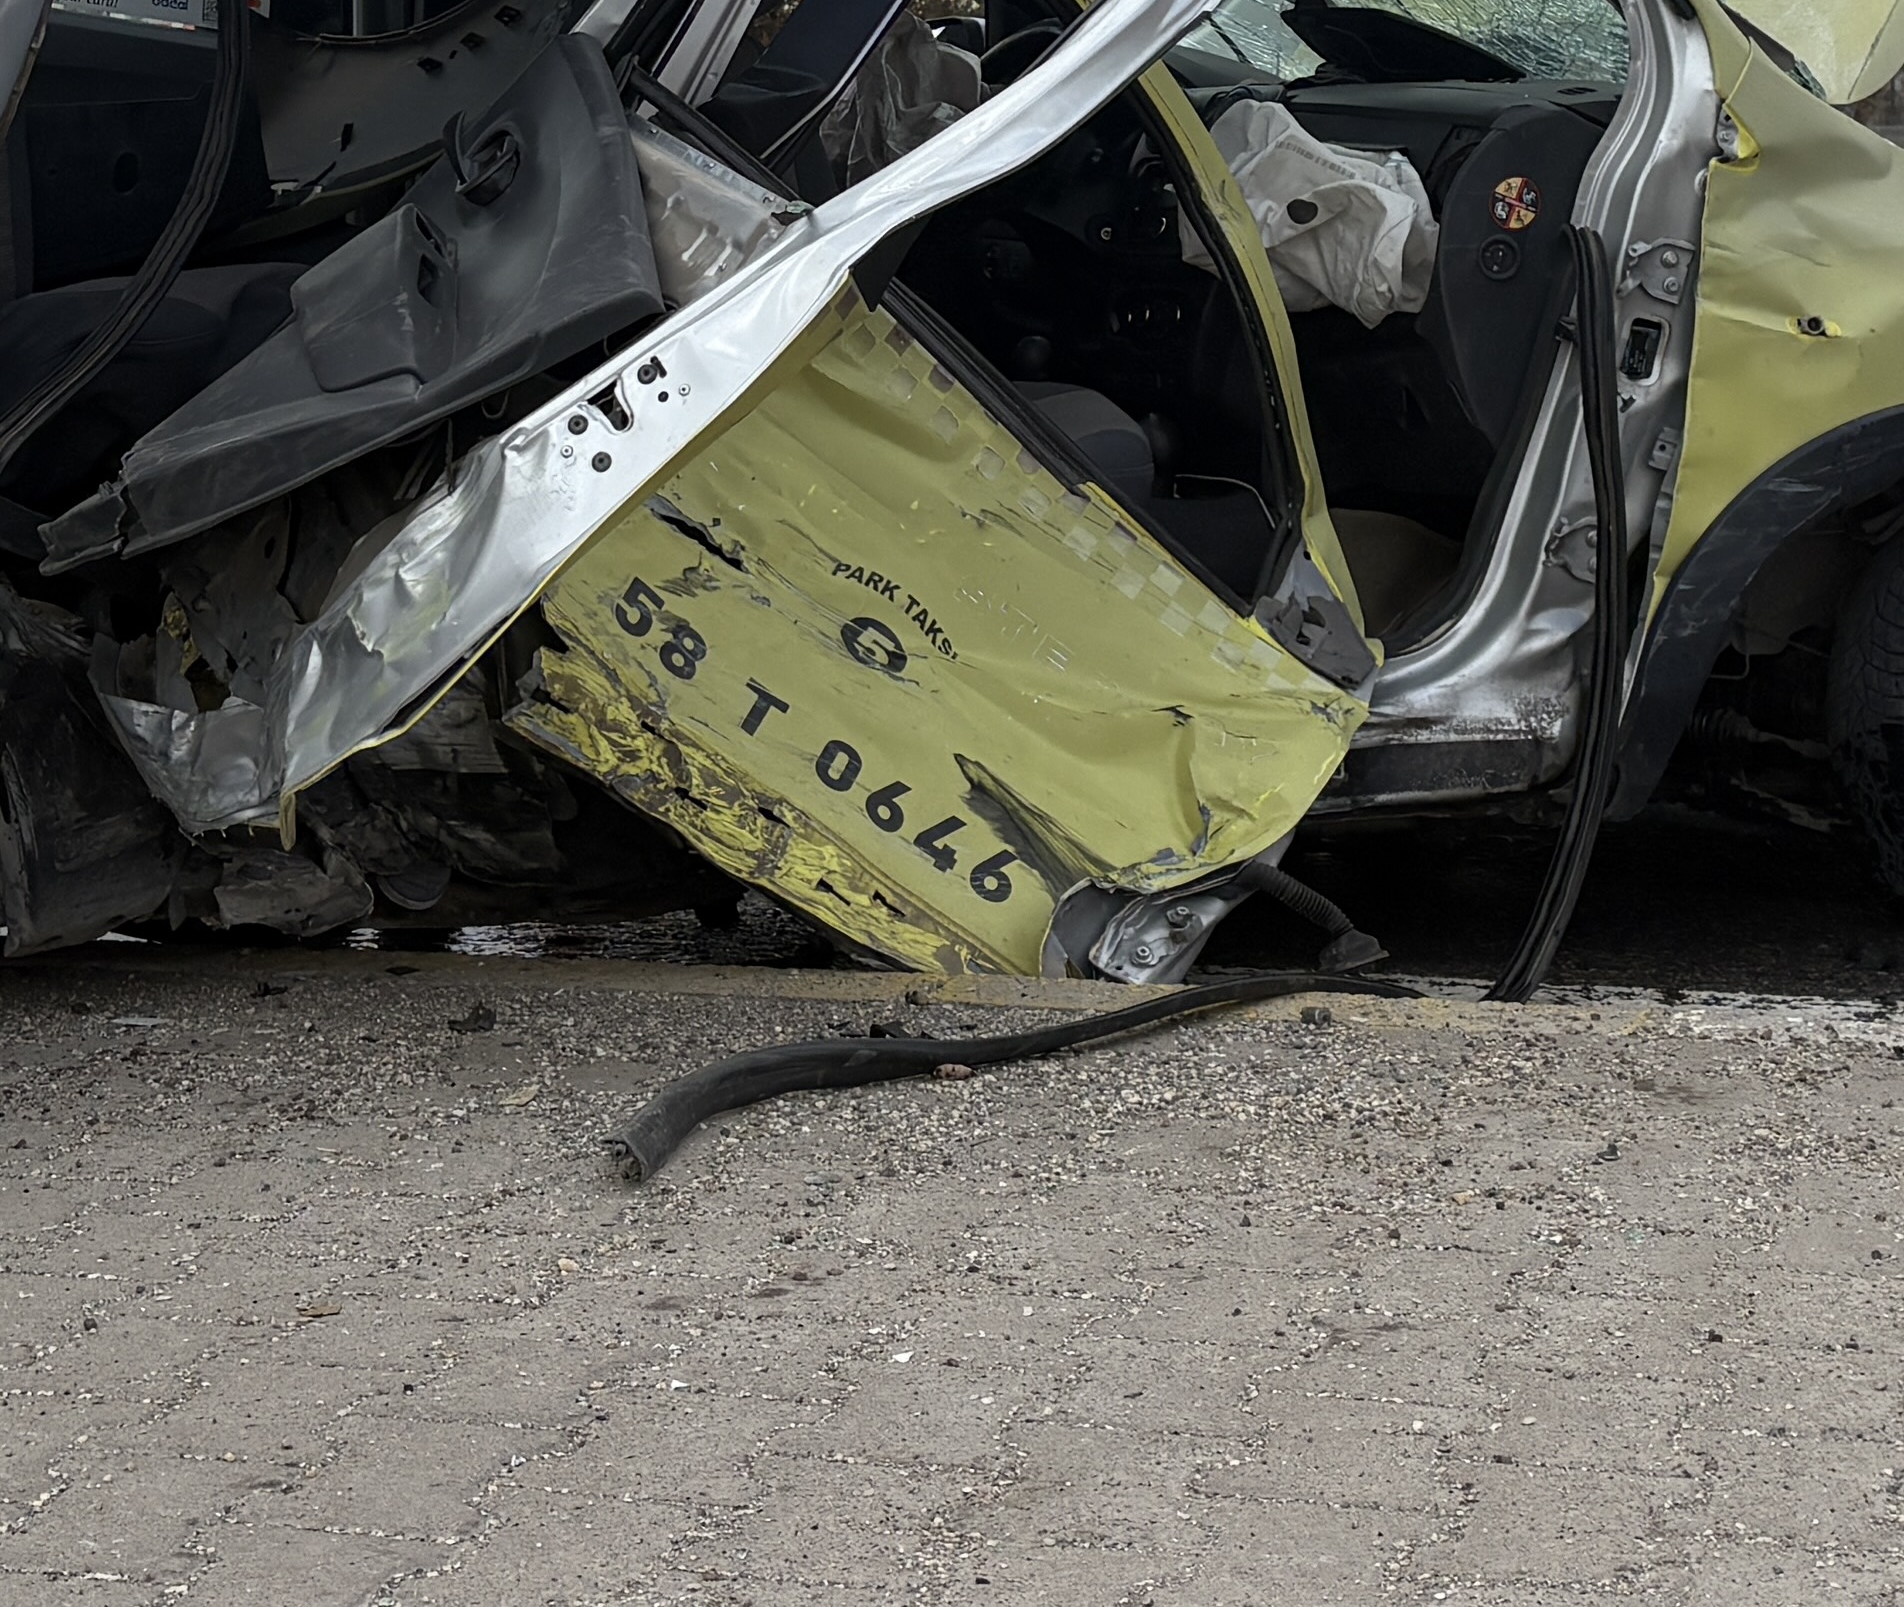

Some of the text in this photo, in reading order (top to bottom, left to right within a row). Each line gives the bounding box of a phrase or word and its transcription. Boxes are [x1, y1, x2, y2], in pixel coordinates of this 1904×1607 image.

[831, 561, 901, 603] PARK
[614, 577, 1014, 903] 58 T 0646
